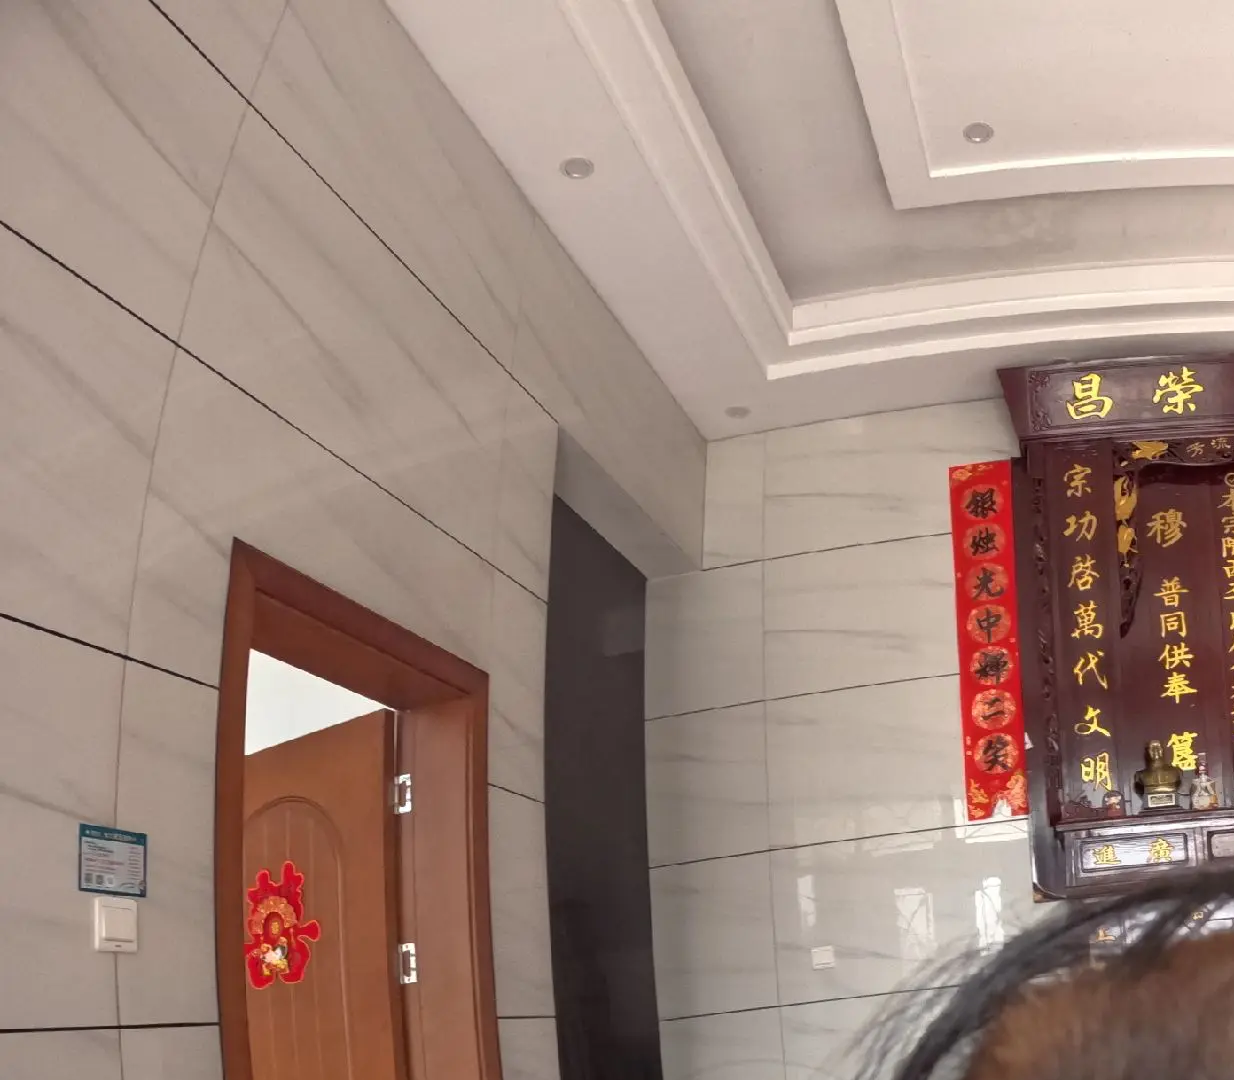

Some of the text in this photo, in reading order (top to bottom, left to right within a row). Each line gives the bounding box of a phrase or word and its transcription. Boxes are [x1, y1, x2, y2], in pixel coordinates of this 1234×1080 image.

[1146, 508, 1187, 548] 穆
[1153, 576, 1197, 704] 普同供奉
